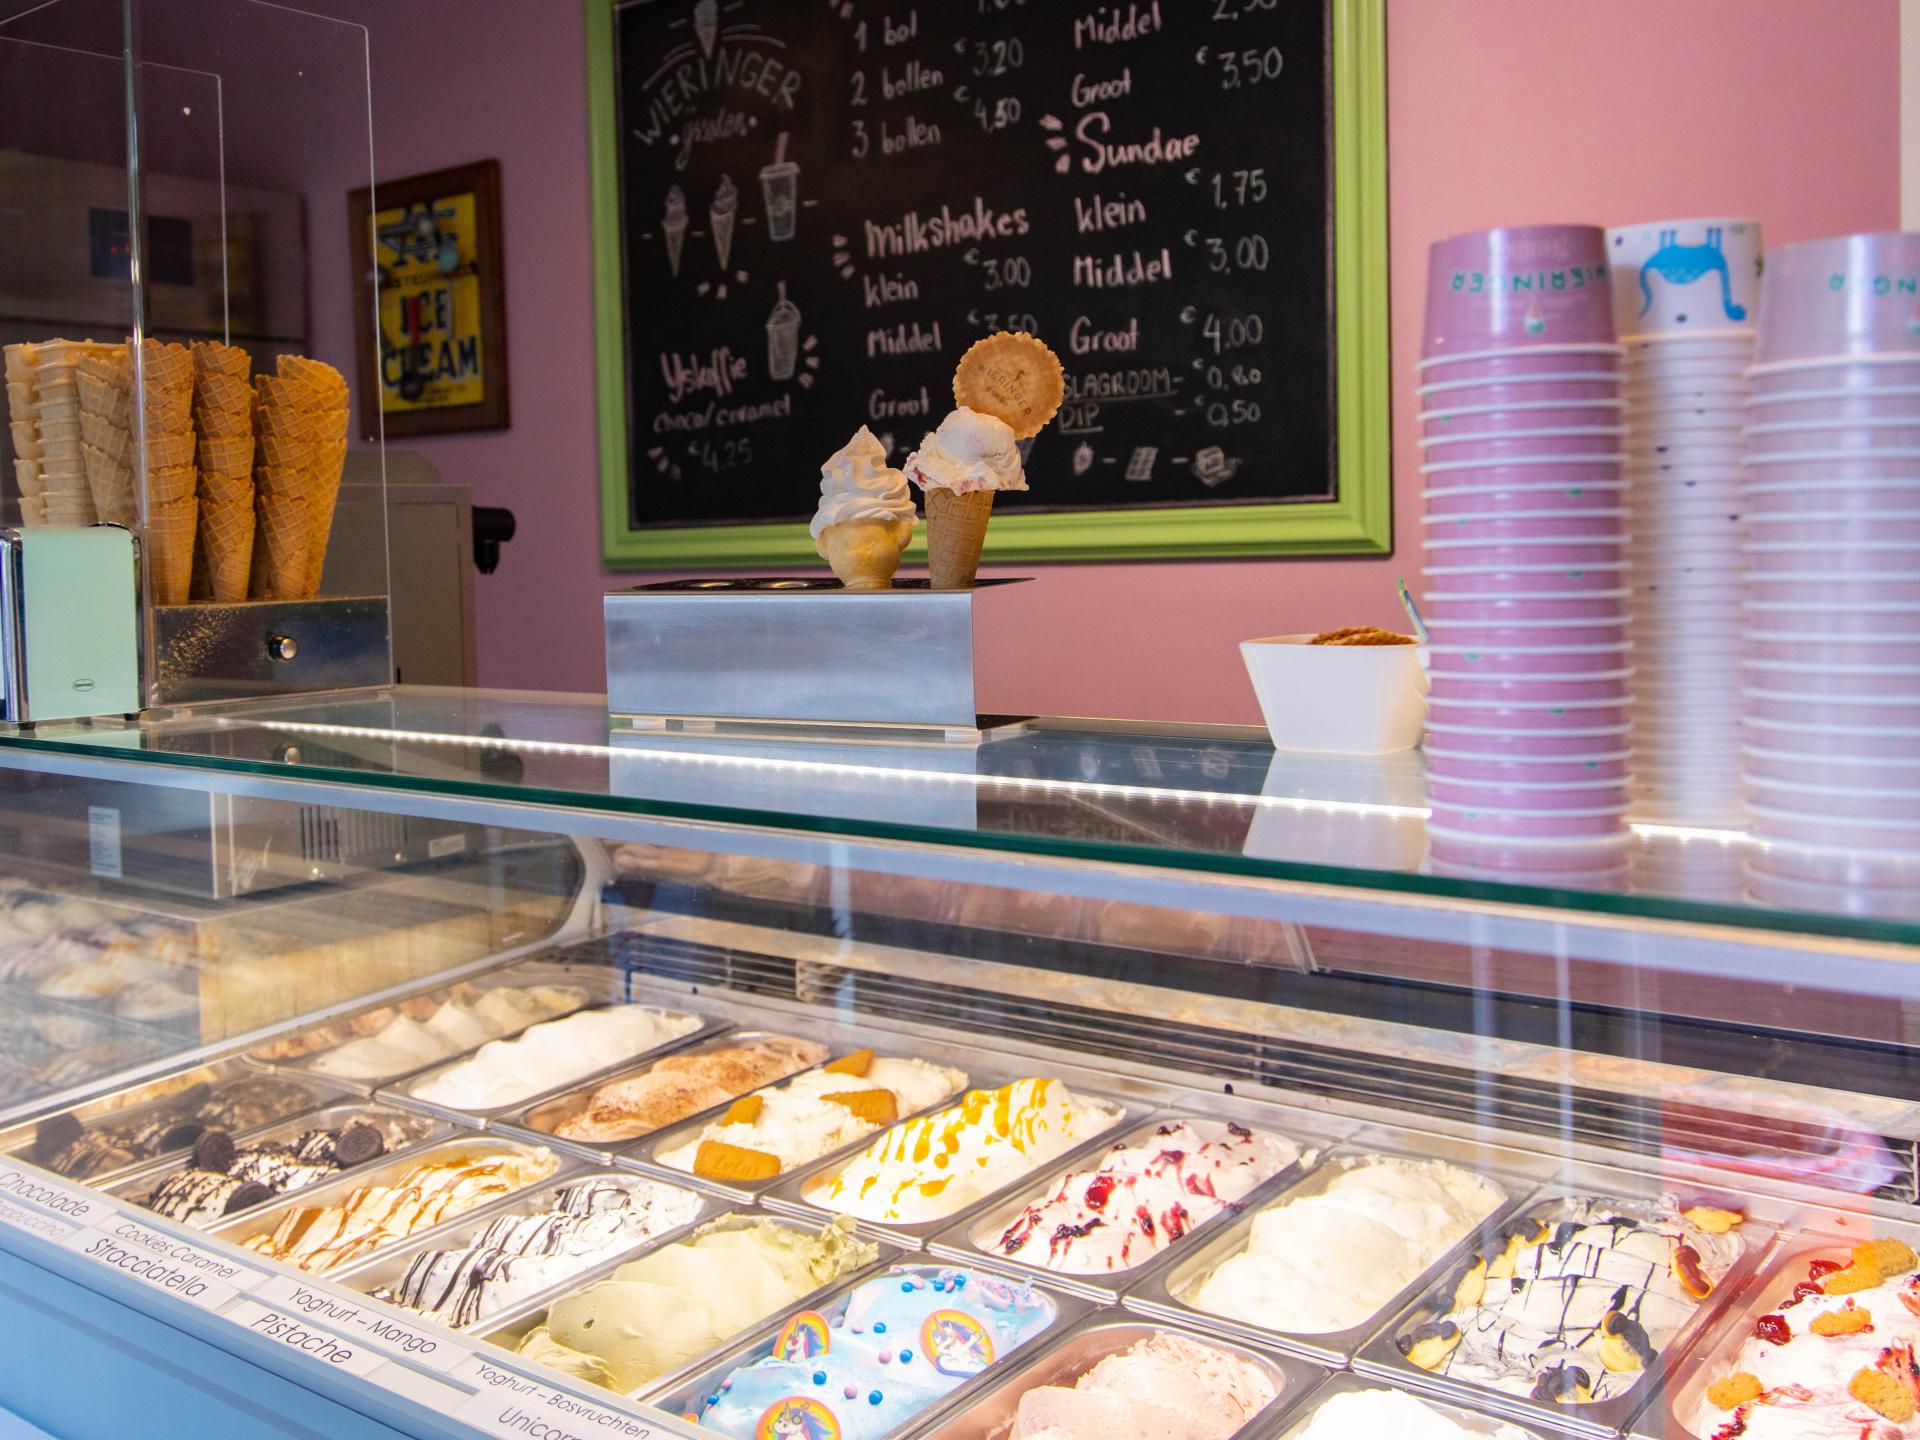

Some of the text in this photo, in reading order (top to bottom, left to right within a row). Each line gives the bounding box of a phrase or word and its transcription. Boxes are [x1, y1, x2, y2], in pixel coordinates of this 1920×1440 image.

[853, 20, 868, 52] 1
[883, 9, 918, 46] bol
[1074, 1, 1162, 50] Middel
[632, 46, 802, 146] WIERINGER
[850, 70, 868, 106] 2
[881, 60, 944, 99] bollen
[1071, 66, 1132, 108] Groot
[851, 115, 941, 158] 3 bollen
[1075, 112, 1200, 173] Sundae
[1075, 192, 1146, 233] klein
[1073, 248, 1172, 288] Middel
[867, 321, 942, 357] Middel
[1070, 315, 1140, 355] Groot
[868, 385, 931, 420] Groot
[1058, 403, 1100, 428] DIP
[0, 1172, 90, 1217] Chocolade
[85, 1238, 208, 1297] Stracciatella
[115, 1224, 242, 1279] Cookies Caramel
[251, 1313, 352, 1363] Pistache
[288, 1287, 359, 1322] Yoghurt
[367, 1320, 437, 1354] Mango
[475, 1364, 538, 1396] Yoghurt
[547, 1393, 650, 1439] Bosvruchten
